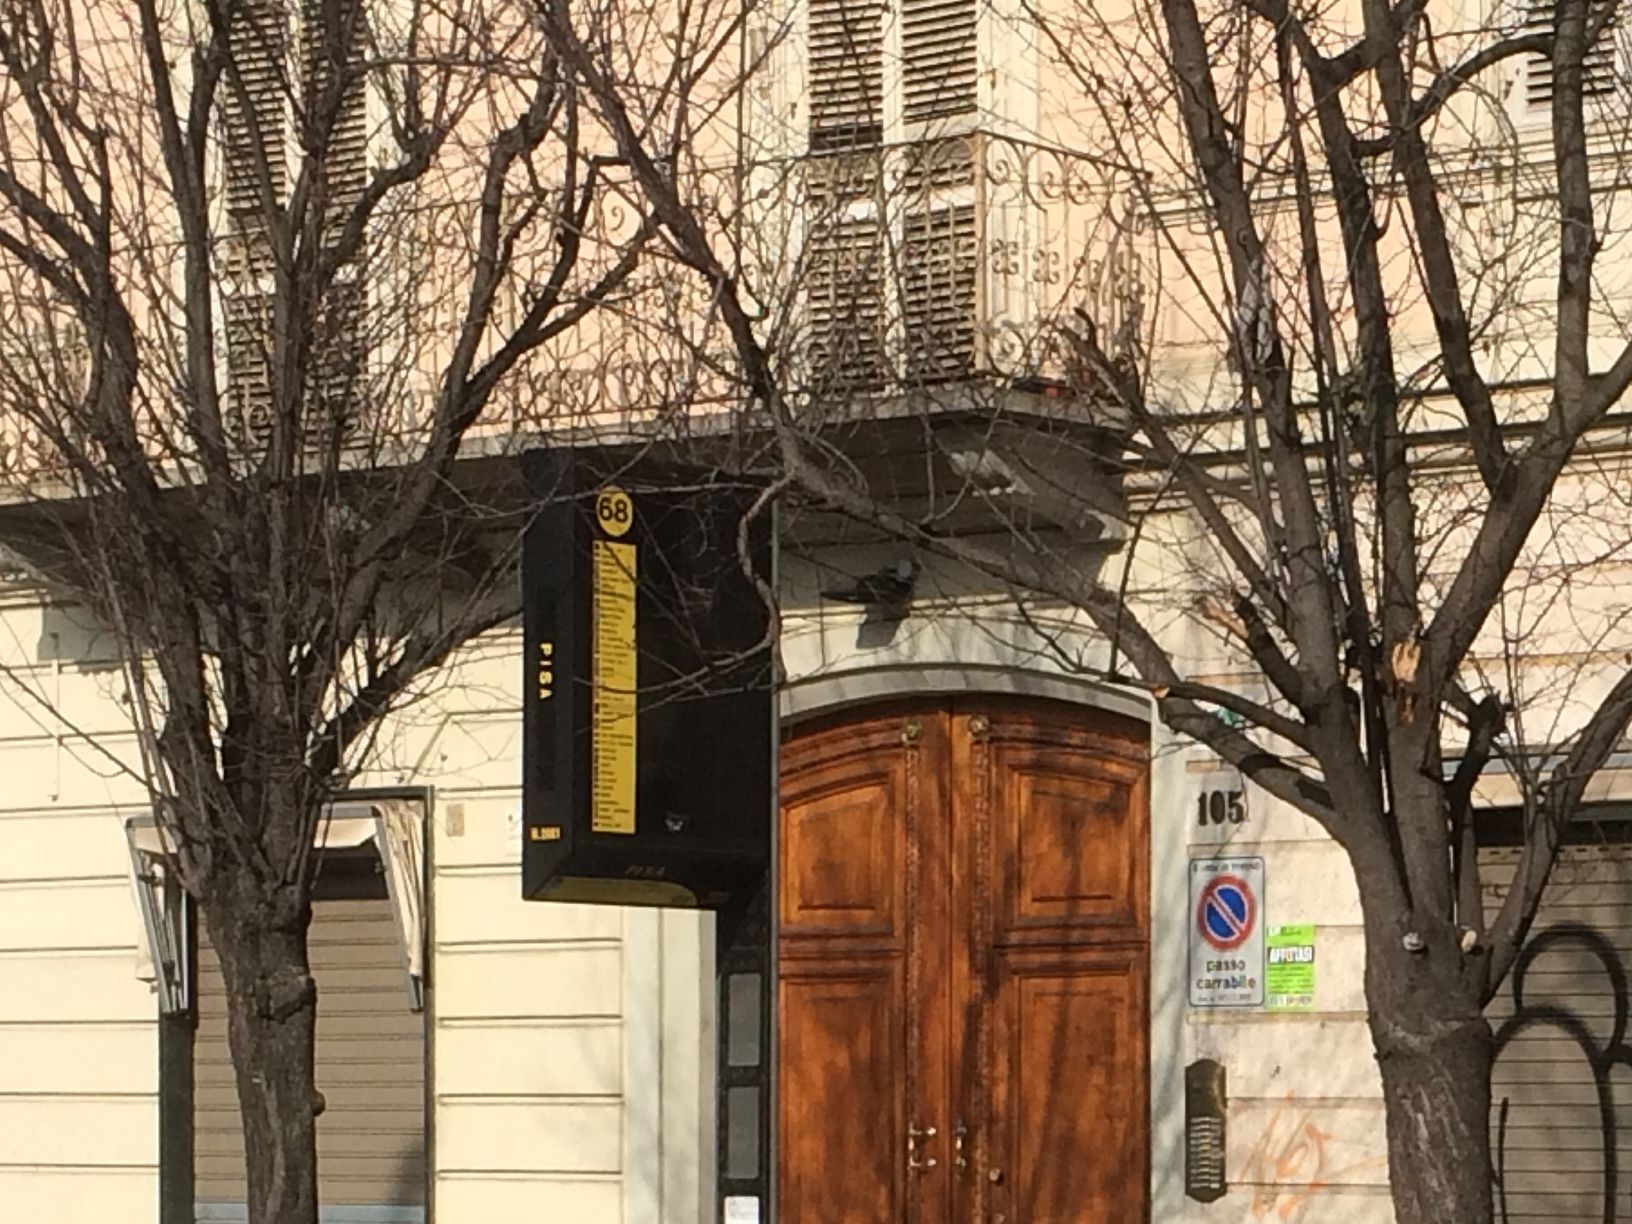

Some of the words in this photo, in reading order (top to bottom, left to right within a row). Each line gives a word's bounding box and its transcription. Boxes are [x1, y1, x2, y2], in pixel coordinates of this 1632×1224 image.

[599, 496, 629, 524] 68
[1196, 789, 1246, 826] 105
[1205, 959, 1246, 974] passo
[1195, 974, 1258, 990] carrabile
